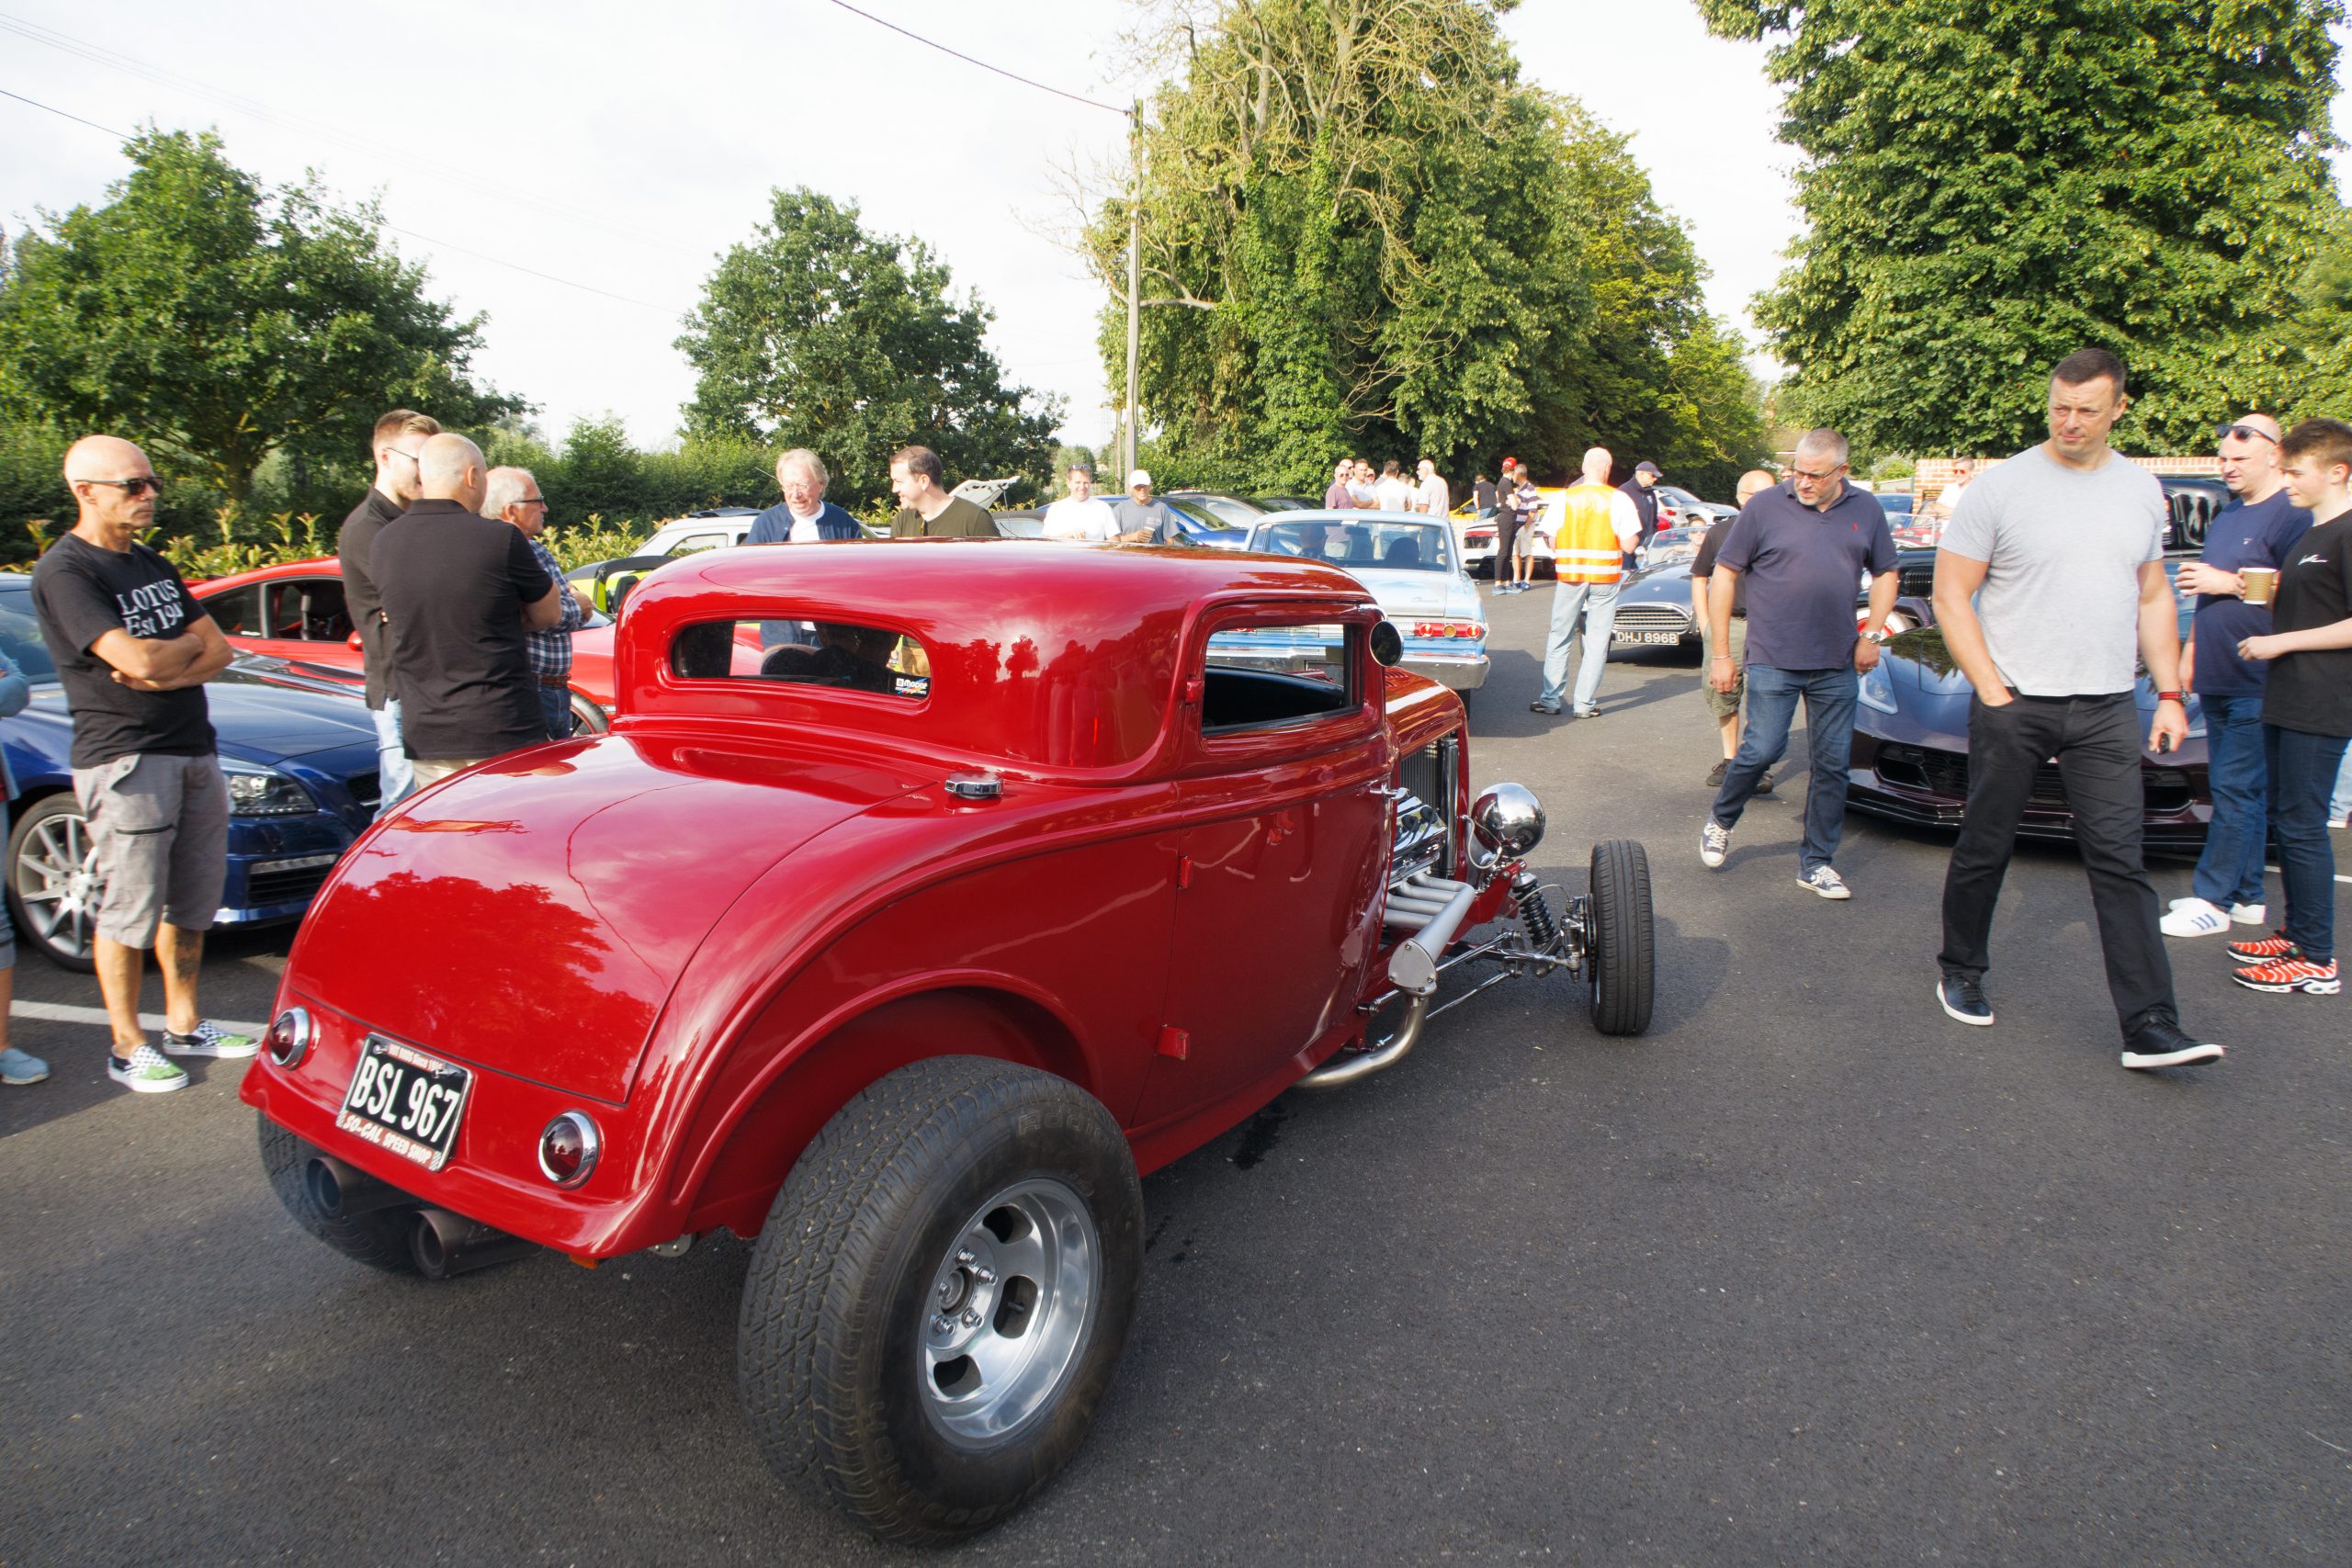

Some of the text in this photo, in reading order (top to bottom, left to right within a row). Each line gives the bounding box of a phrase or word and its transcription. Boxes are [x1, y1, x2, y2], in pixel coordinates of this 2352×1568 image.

[116, 579, 181, 615] LOTUS
[122, 601, 185, 637] Est 194
[1617, 631, 1678, 644] DHJ 896B
[349, 1055, 461, 1143] BSL 967
[343, 1114, 433, 1165] SO-CAL SPEED SHOP
